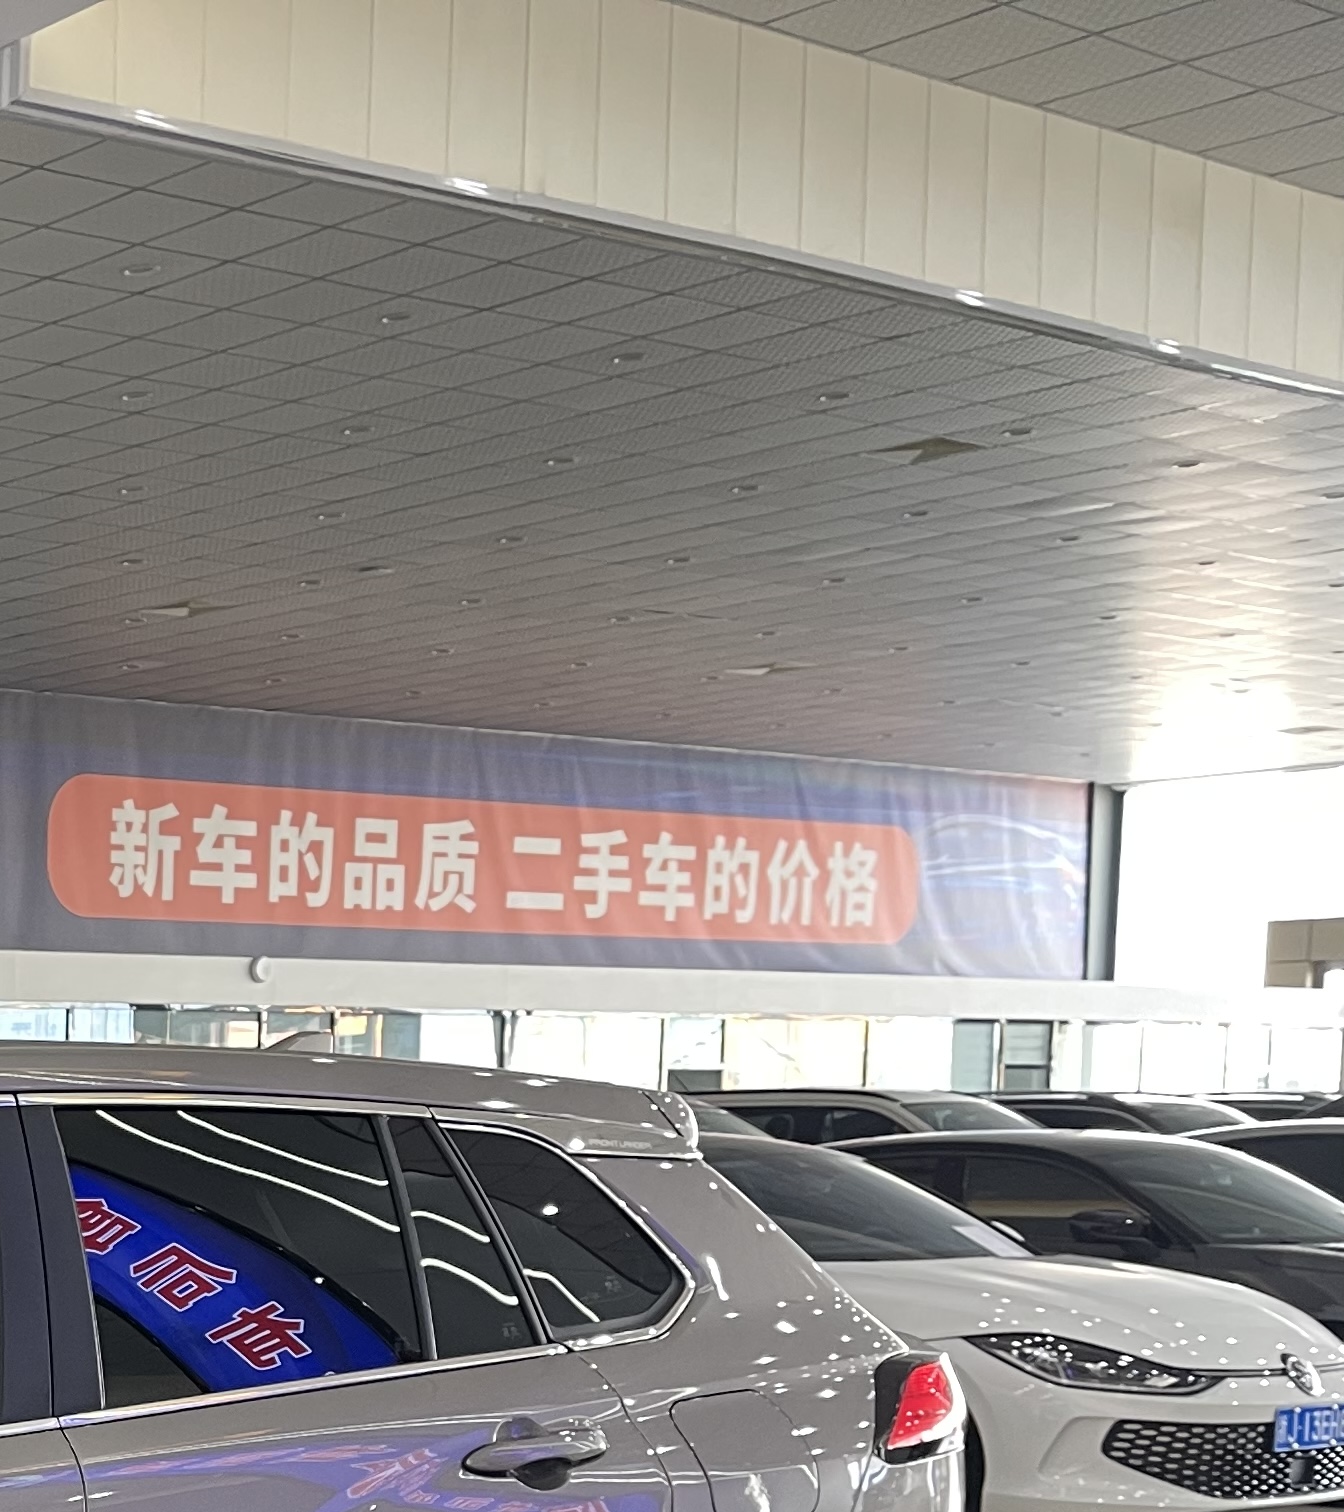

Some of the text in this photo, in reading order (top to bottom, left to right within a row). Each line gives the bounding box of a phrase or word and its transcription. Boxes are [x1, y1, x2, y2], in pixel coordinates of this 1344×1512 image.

[108, 798, 880, 928] 新车的品质 二手车的价格
